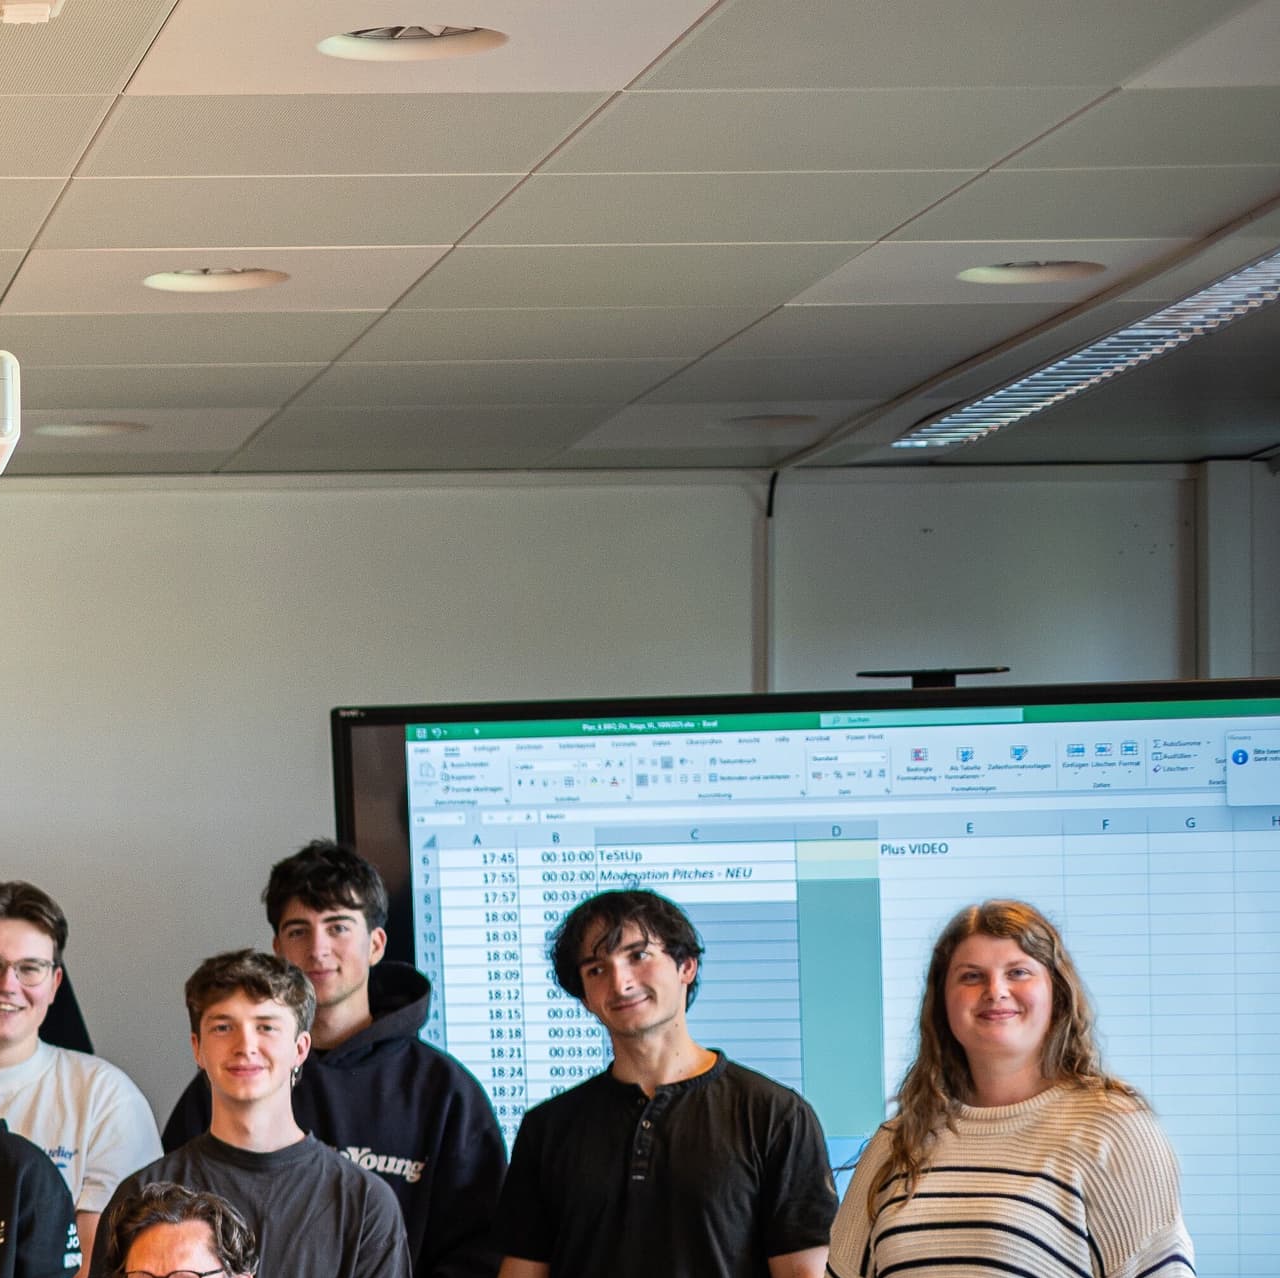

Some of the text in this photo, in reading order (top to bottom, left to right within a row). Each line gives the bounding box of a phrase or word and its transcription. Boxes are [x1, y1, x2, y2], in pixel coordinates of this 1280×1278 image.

[966, 822, 974, 834] E
[1102, 818, 1110, 831] F
[1185, 817, 1196, 829] G
[552, 832, 561, 844] B
[690, 828, 700, 841] C
[831, 825, 842, 838] D
[473, 833, 482, 846] A
[881, 842, 949, 855] Plus VIDEO
[482, 852, 516, 865] 17:45
[541, 850, 595, 863] 00:10:00
[483, 871, 516, 884] 17:55
[542, 870, 595, 882] 00:02:00
[672, 868, 714, 880] Pitches
[725, 867, 753, 879] NEU
[484, 891, 516, 904] 17:57
[485, 911, 517, 923] 18:00
